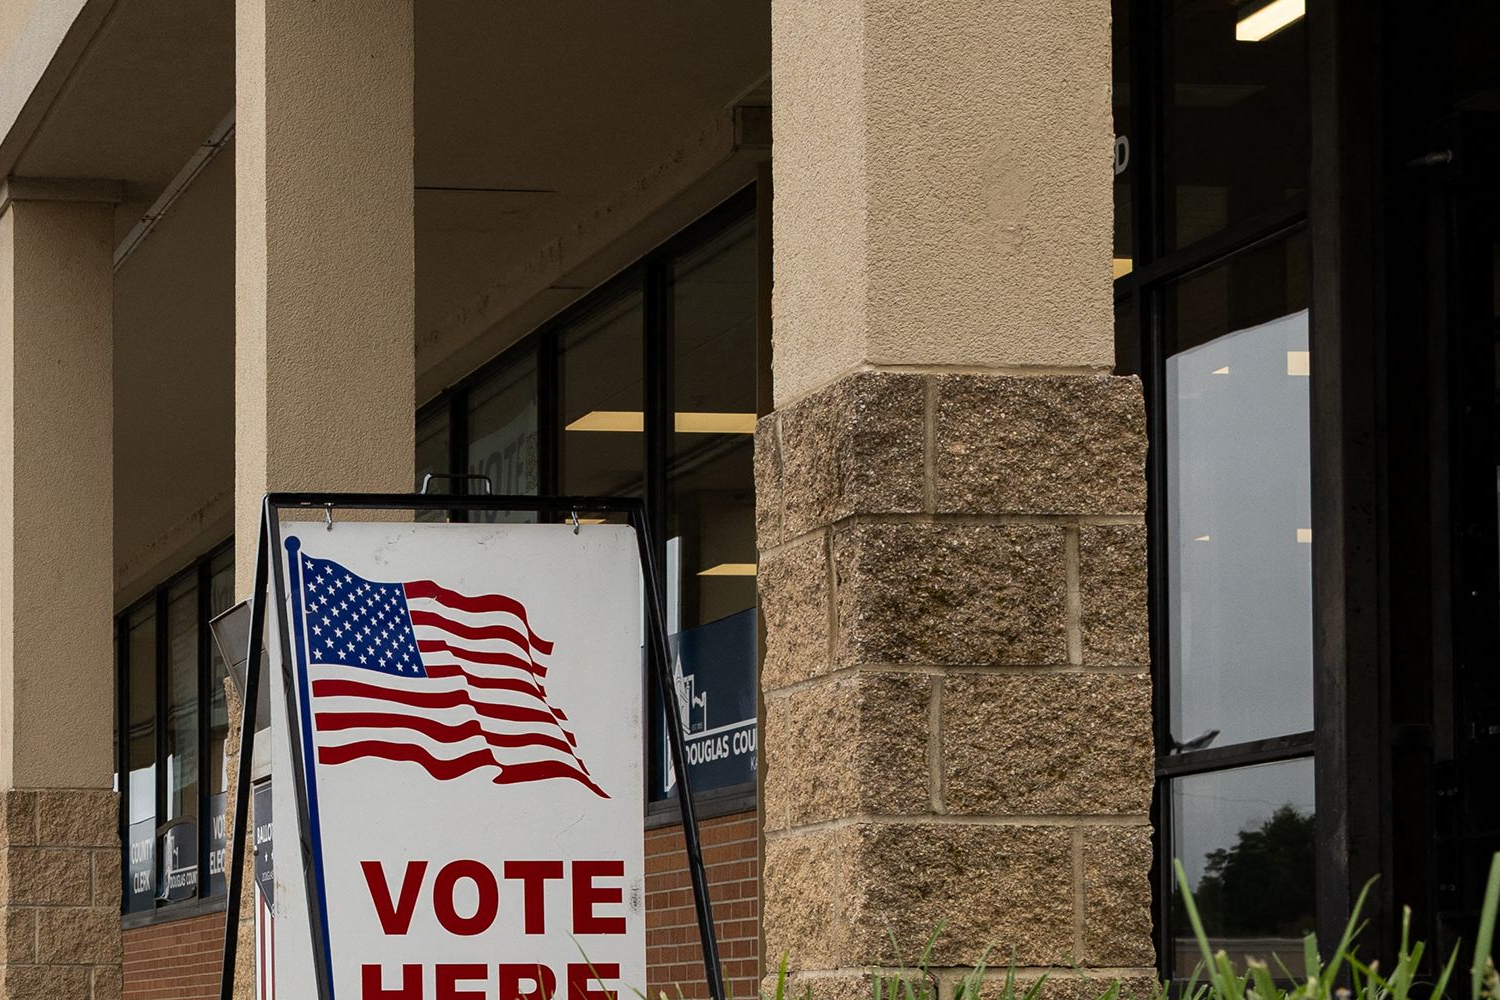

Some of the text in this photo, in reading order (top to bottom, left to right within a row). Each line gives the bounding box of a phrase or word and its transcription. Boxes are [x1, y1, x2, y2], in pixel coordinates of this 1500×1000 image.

[733, 728, 757, 755] COU
[257, 823, 273, 845] BALLO
[131, 837, 152, 865] COUNTY
[360, 860, 627, 936] VOTE
